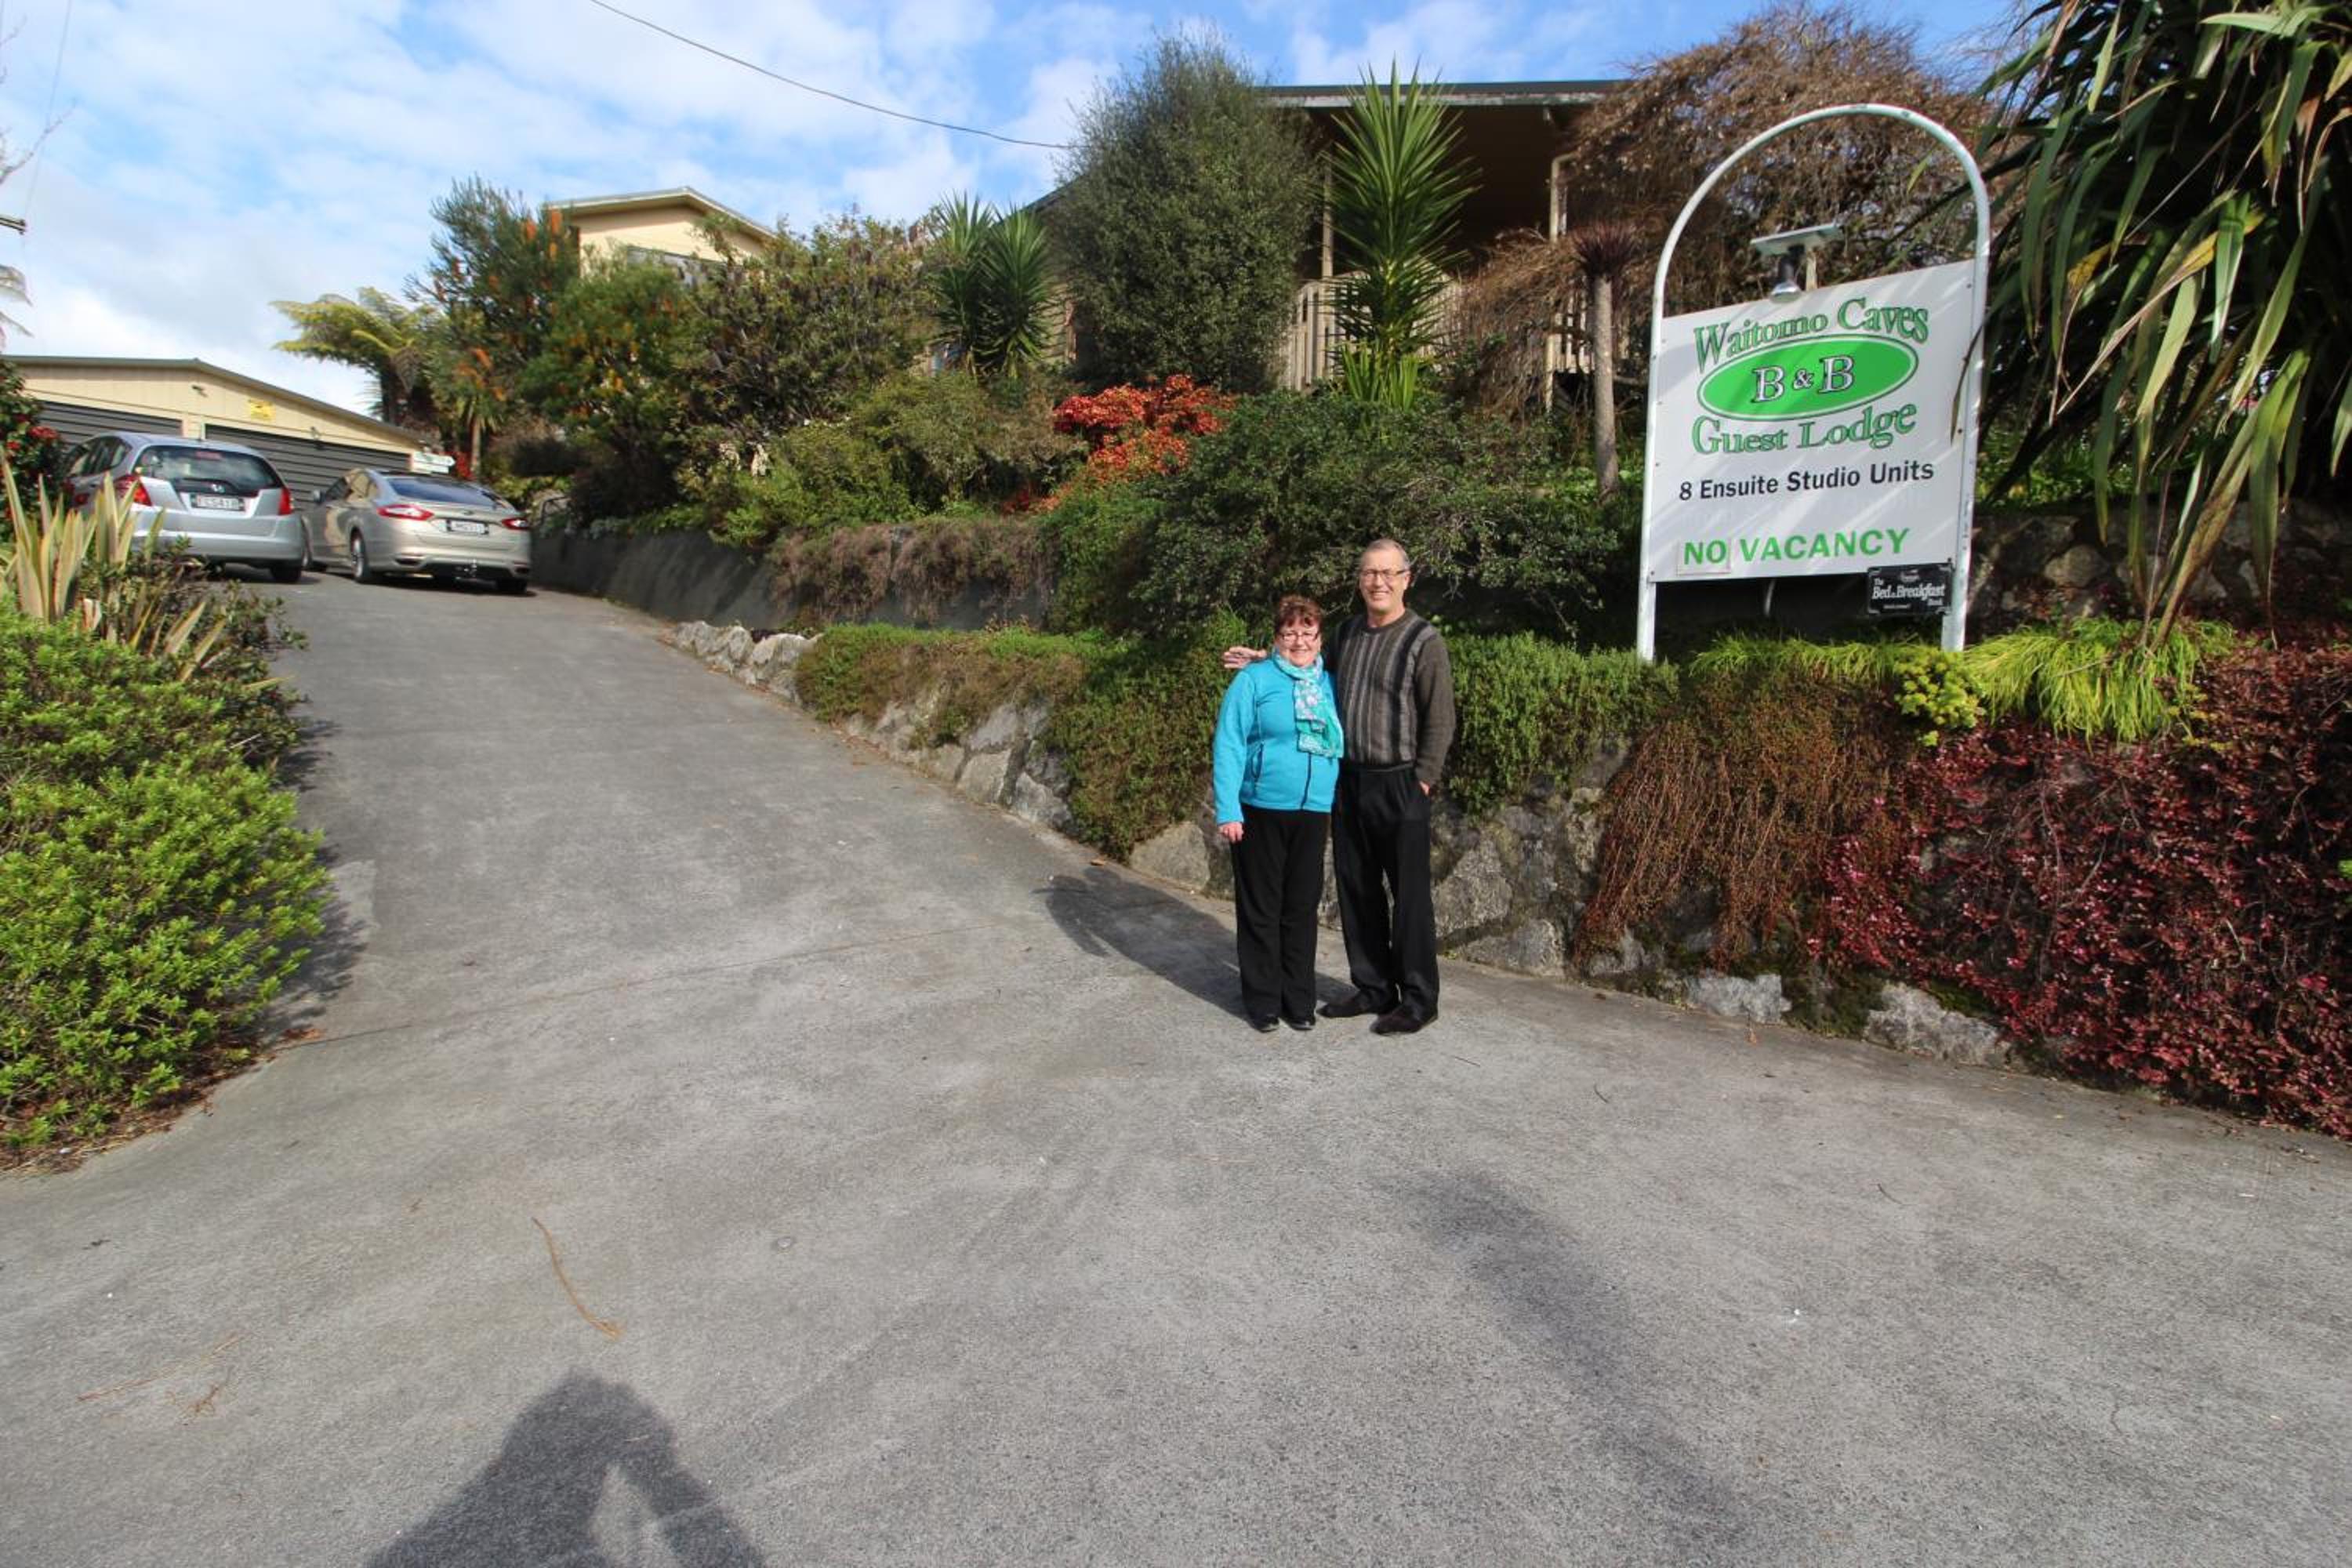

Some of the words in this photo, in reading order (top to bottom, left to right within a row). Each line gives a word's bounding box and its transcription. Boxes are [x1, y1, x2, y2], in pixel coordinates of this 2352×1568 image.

[1693, 314, 1828, 374] Waitomo
[1837, 296, 1929, 343] Caves
[1751, 365, 1785, 404] B
[1792, 368, 1813, 390] &
[1818, 354, 1855, 394] B
[1691, 416, 1788, 455] Guest
[1797, 403, 1918, 449] Lodge
[1679, 481, 1692, 500] 8
[1700, 475, 1779, 499] Ensuite
[1786, 466, 1860, 492] Studio
[1870, 459, 1934, 484] Units
[1683, 539, 1727, 564] NO
[1739, 527, 1910, 562] VACANCY
[1872, 585, 1892, 599] Bed
[1896, 583, 1945, 601] Breakfast
